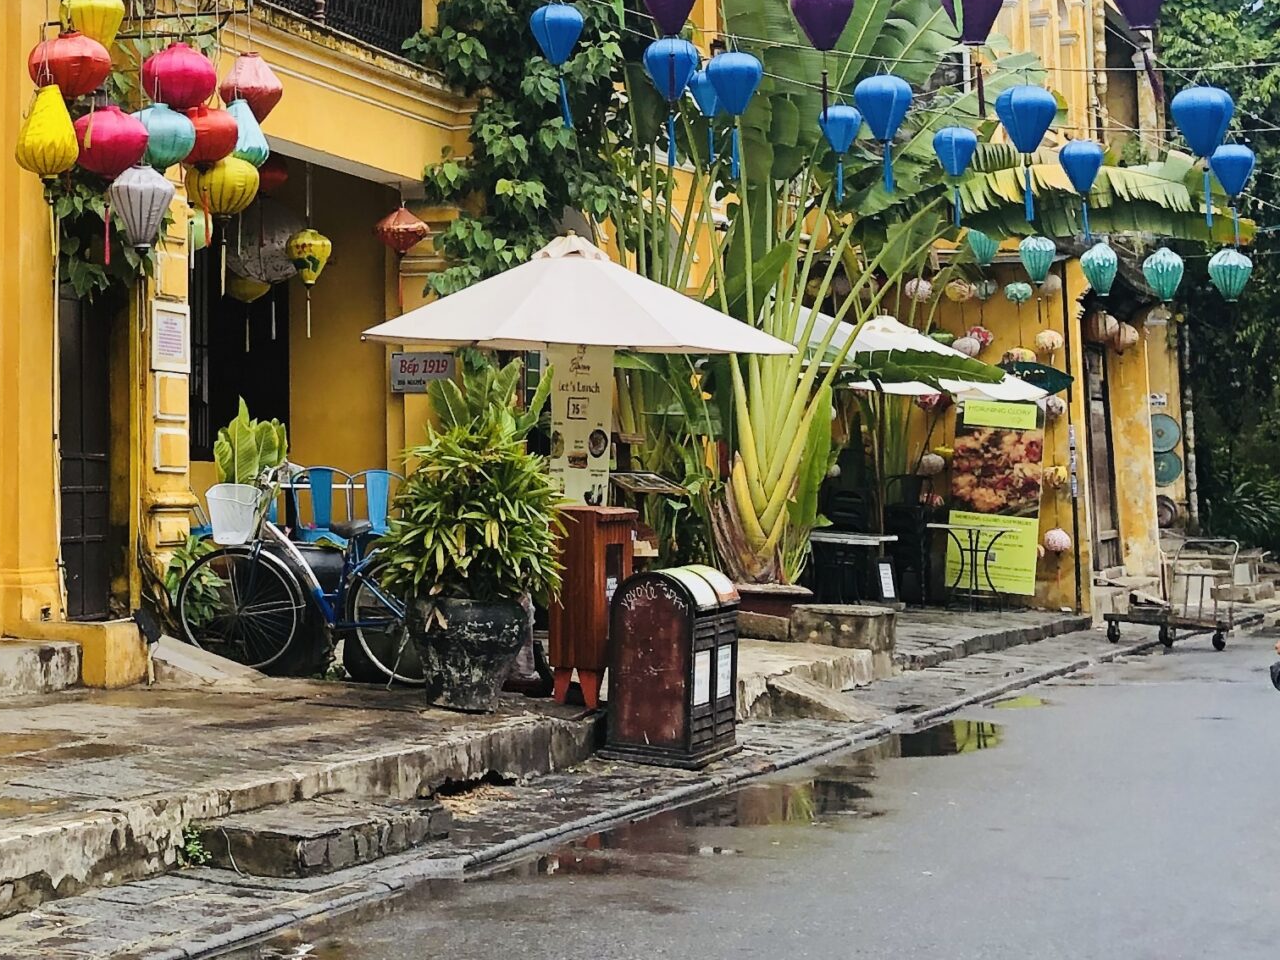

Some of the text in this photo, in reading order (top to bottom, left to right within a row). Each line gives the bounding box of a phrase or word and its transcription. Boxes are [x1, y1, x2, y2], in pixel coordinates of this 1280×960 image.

[400, 357, 448, 377] Bếp 1919
[577, 382, 600, 394] Lunch
[1007, 407, 1032, 416] GLORY
